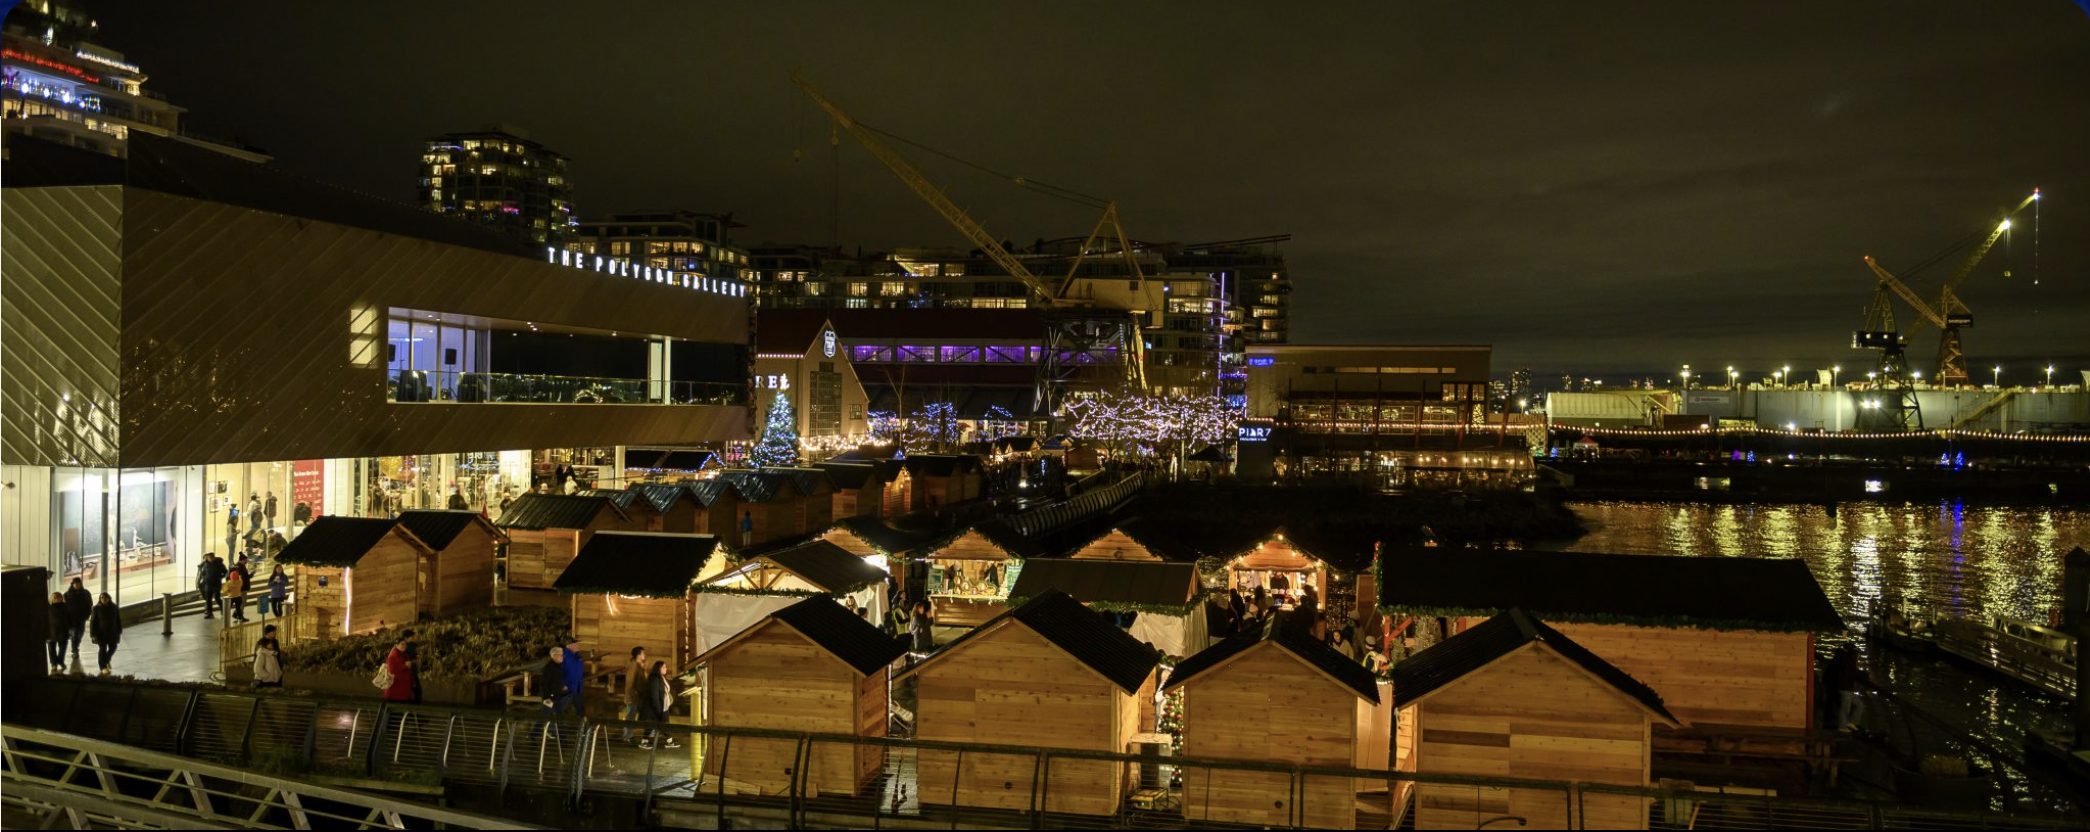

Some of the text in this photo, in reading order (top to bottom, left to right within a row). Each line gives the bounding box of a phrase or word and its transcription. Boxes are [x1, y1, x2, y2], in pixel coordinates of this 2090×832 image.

[548, 246, 745, 298] THE POLYGON GALLERY
[1265, 427, 1272, 437] 7
